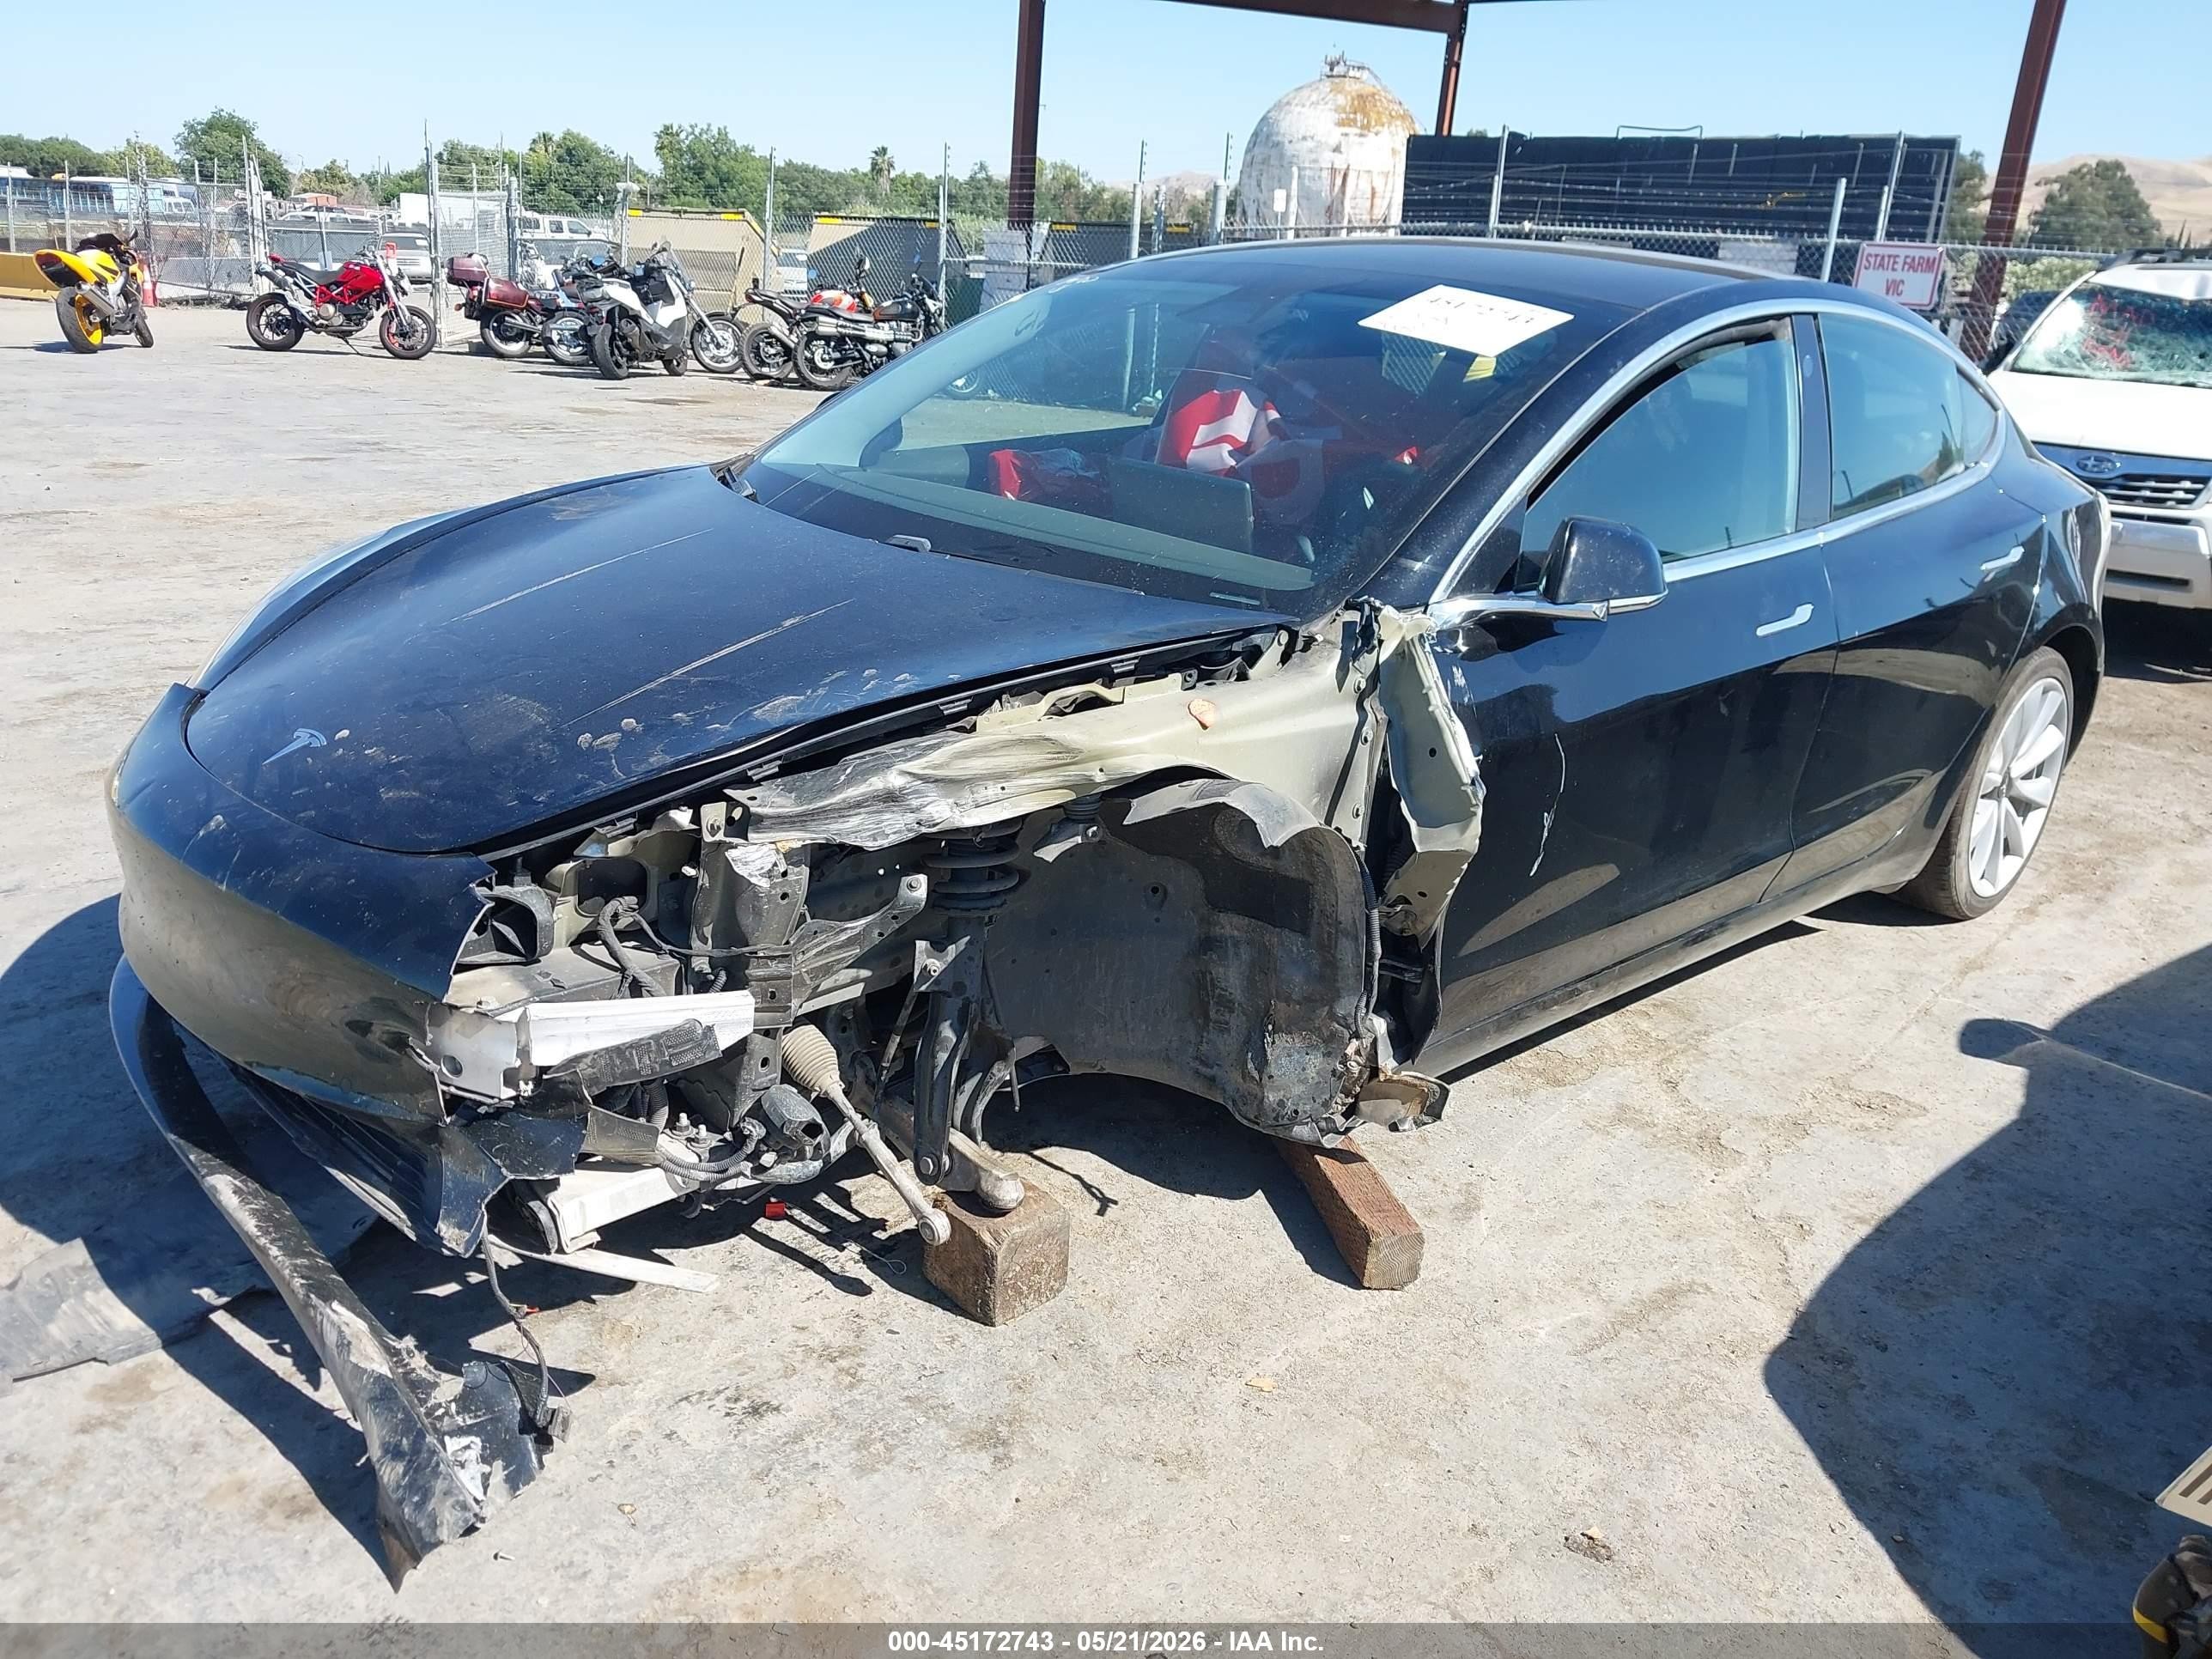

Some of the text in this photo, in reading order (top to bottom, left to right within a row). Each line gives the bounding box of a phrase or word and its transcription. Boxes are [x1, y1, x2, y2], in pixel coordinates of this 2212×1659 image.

[1863, 252, 1936, 274] STATE FARM
[1885, 277, 1905, 296] VIC
